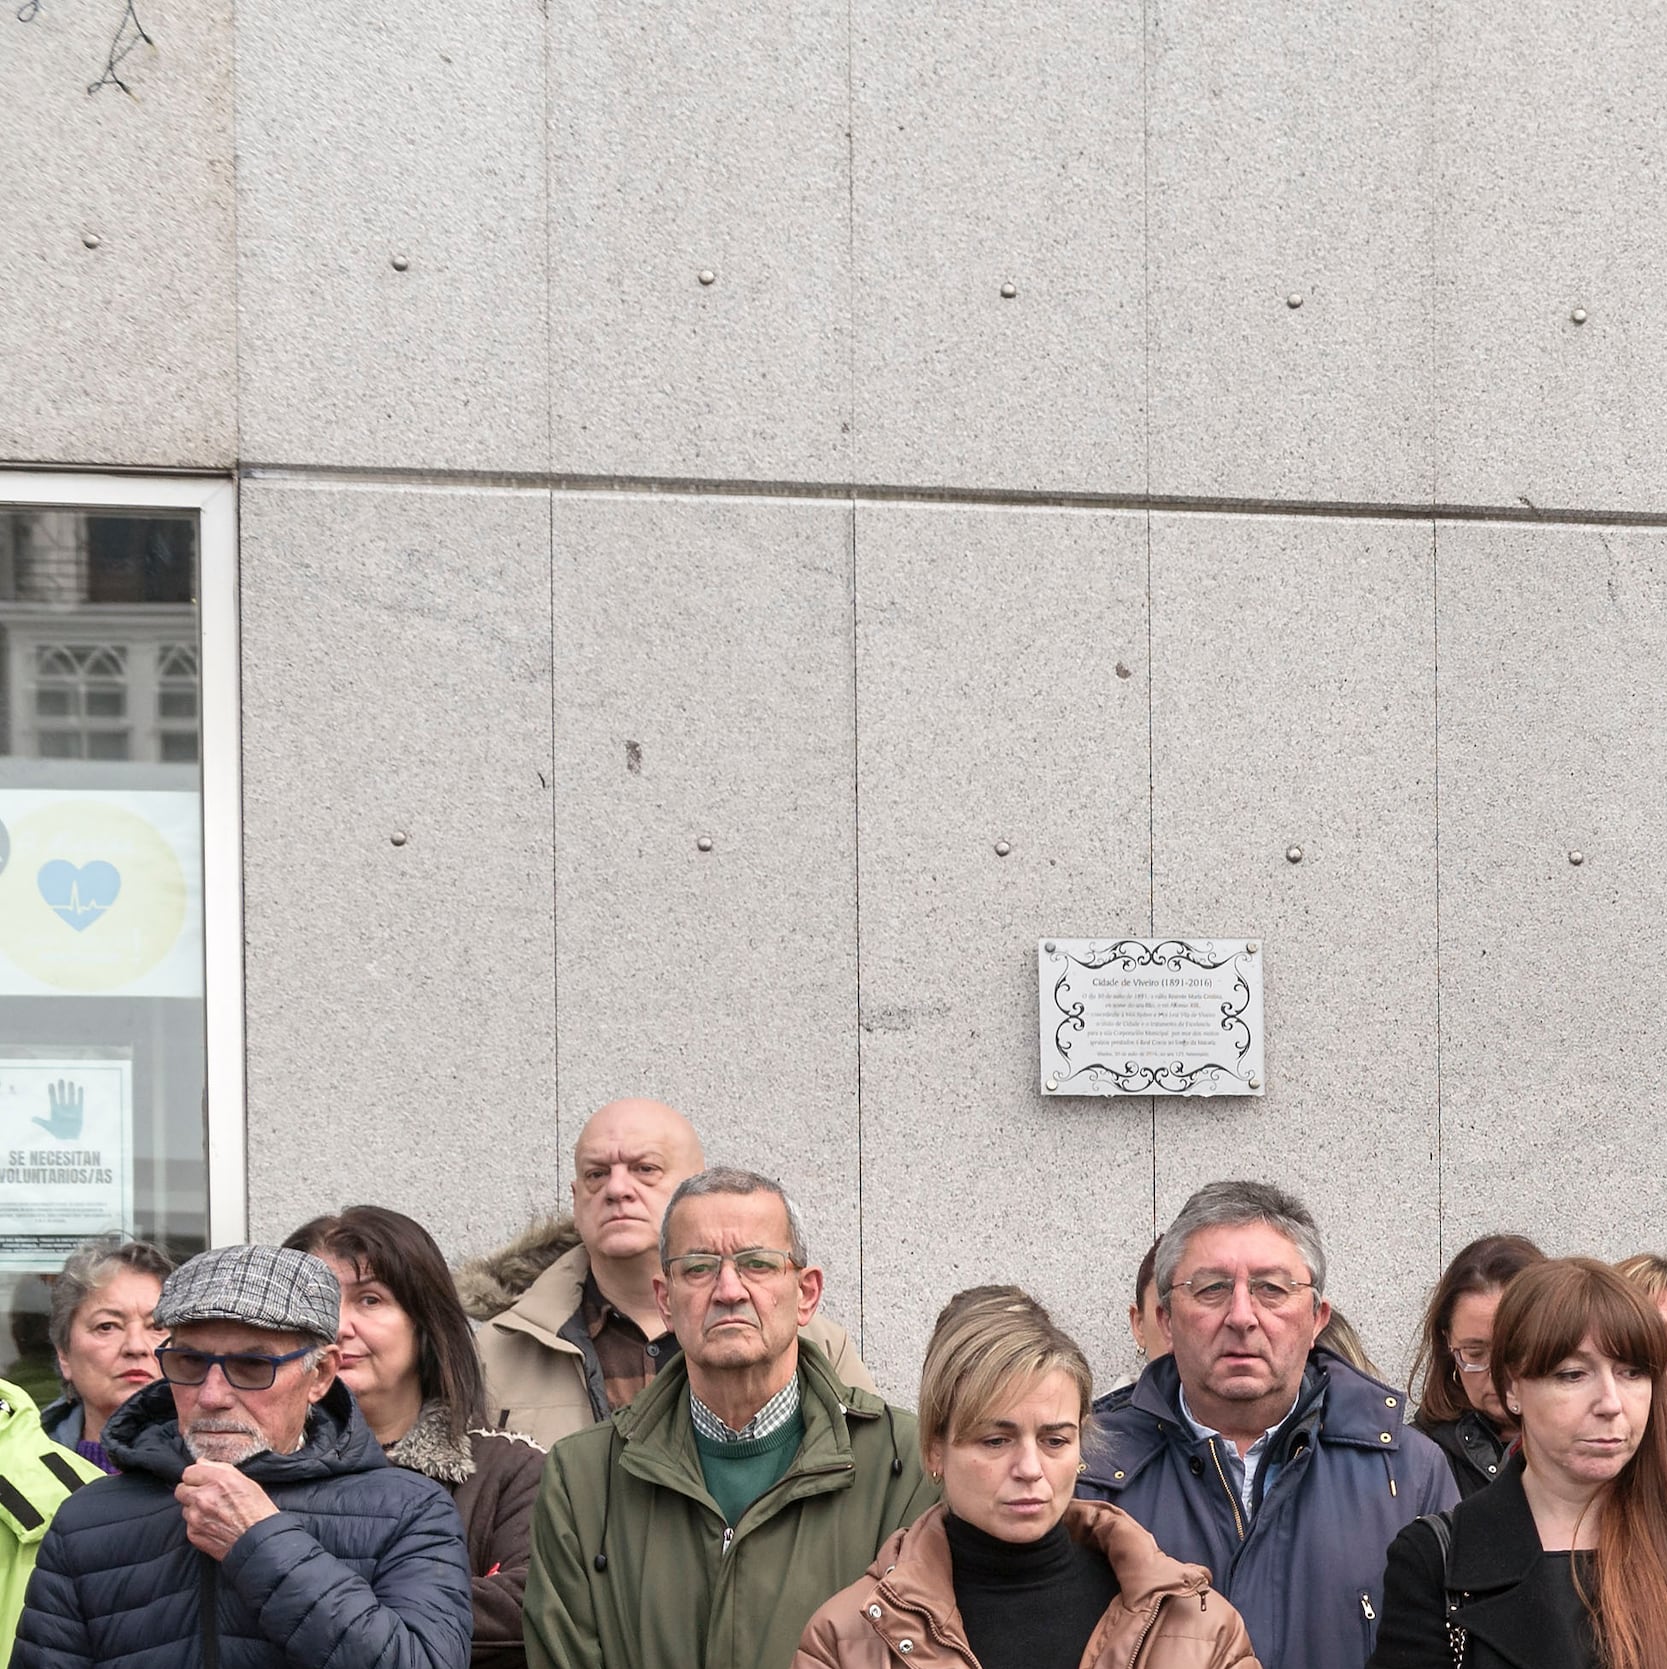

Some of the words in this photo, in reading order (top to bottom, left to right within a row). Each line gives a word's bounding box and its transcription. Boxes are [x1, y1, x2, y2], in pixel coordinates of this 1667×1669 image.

[1092, 978, 1119, 987] Cidade
[1121, 978, 1131, 987] de
[1133, 979, 1159, 987] Viveiro
[1161, 978, 1213, 988] (1891-2016)
[9, 1150, 25, 1166] SE
[30, 1151, 100, 1166] NECESITAN
[0, 1168, 113, 1184] VOLUNTARIOS/AS
